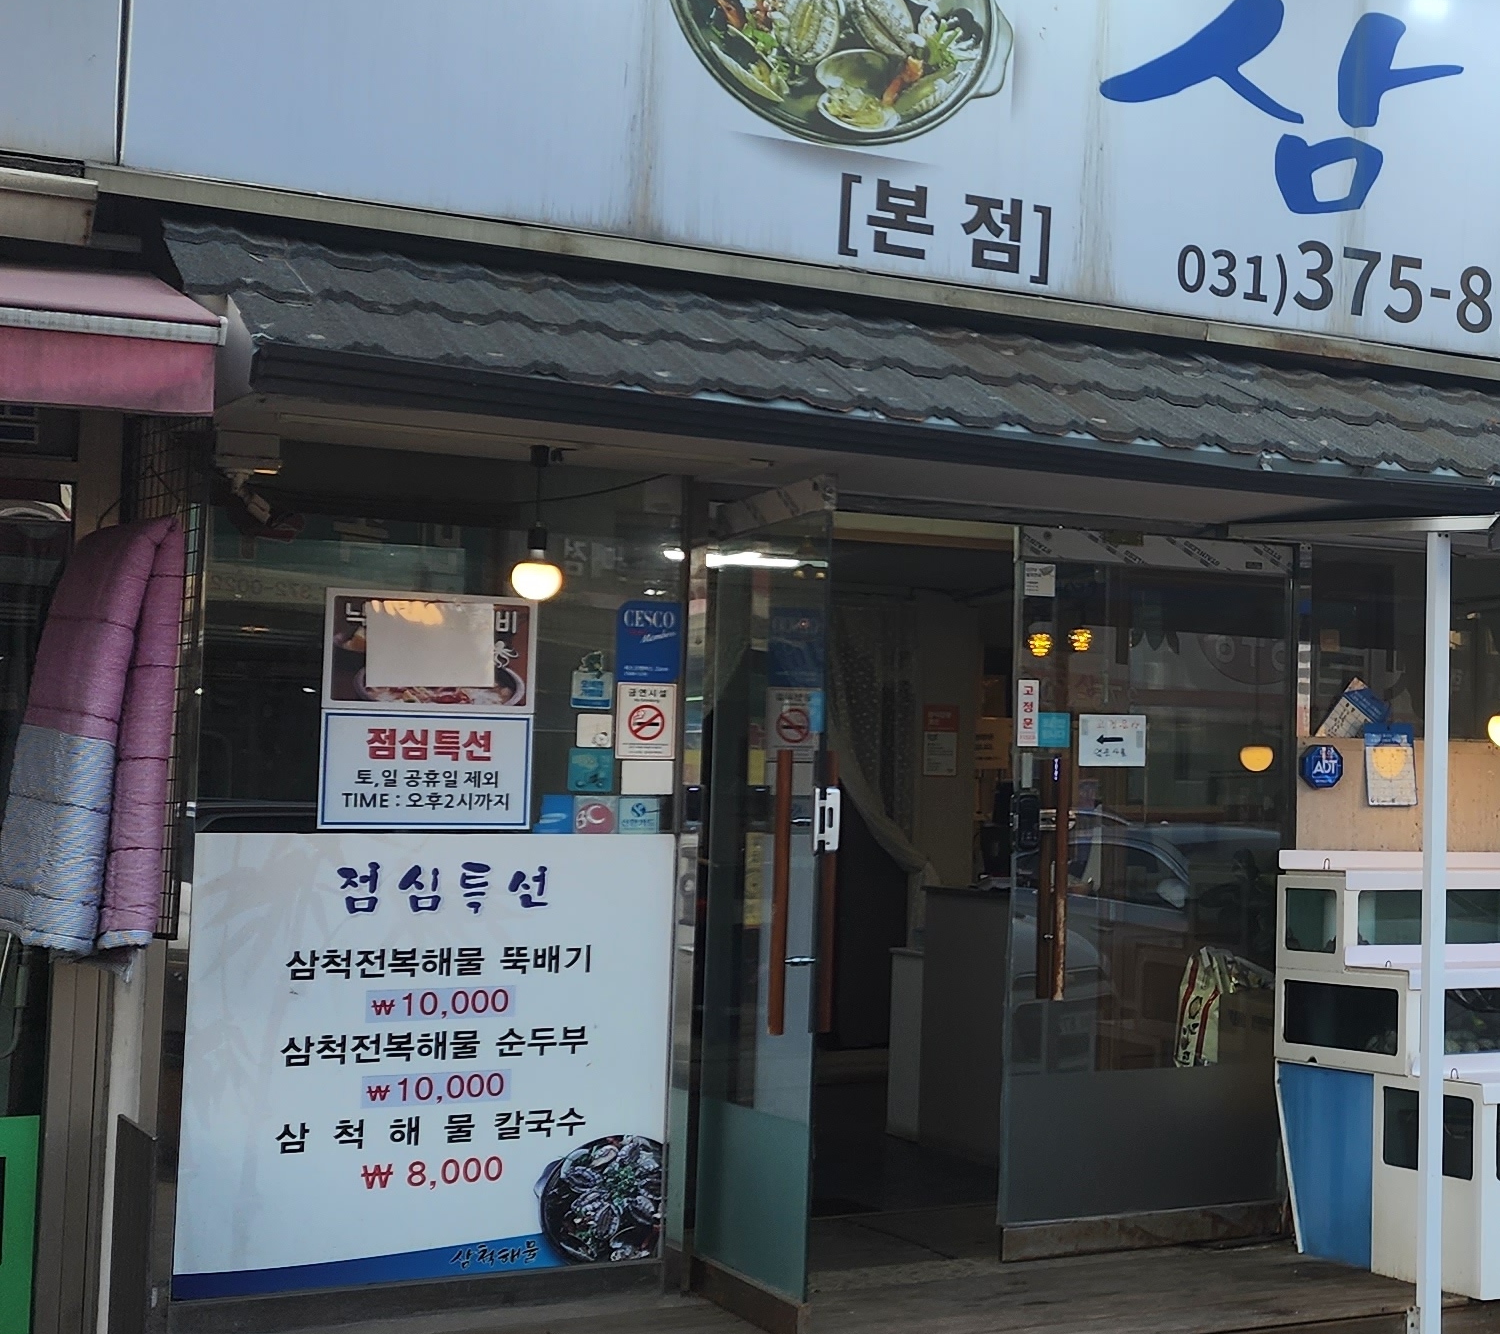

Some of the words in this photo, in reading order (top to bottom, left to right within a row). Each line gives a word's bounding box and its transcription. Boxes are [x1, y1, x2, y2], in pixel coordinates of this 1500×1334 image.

[623, 609, 675, 629] CESCO
[366, 729, 492, 761] 점심특선
[406, 770, 458, 788] 공휴일
[465, 770, 499, 789] 제외
[1313, 760, 1337, 774] ADT
[342, 793, 389, 809] TIME
[406, 793, 510, 812] 오후2시까지
[576, 805, 605, 830] BC
[286, 946, 486, 981] 삼척전복해물
[501, 943, 593, 974] 뚝배기
[280, 1029, 481, 1068] 삼척전복해물
[496, 1025, 589, 1058] 순두부
[495, 1106, 587, 1140] 칼국수
